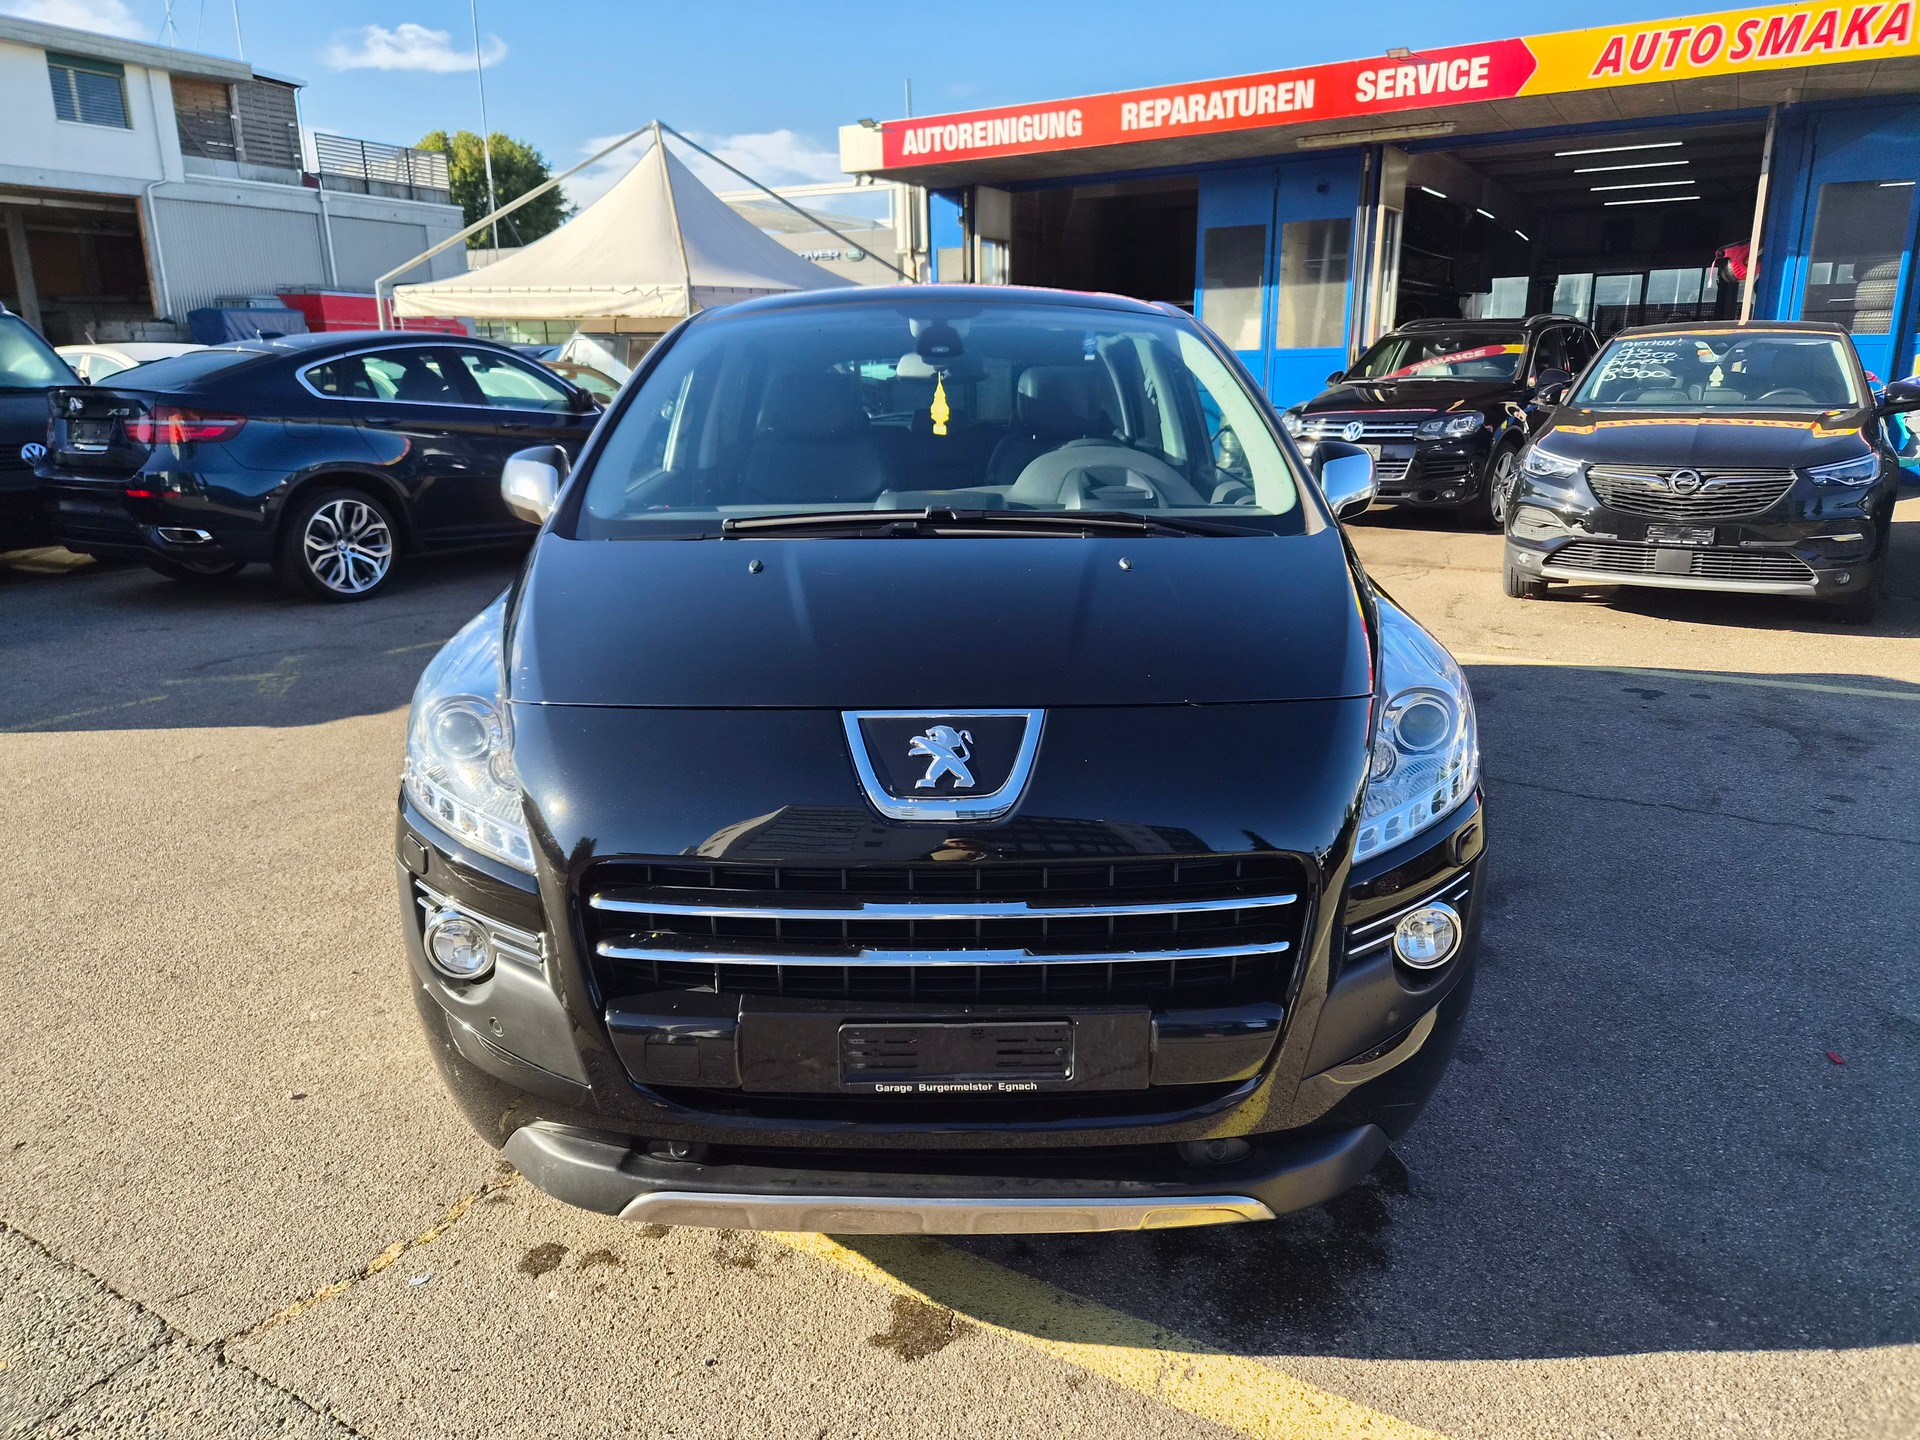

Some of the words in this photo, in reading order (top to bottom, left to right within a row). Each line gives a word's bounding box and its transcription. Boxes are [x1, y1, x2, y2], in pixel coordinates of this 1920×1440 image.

[1592, 24, 1724, 76] AUTO
[1730, 2, 1909, 60] SMAKA
[902, 109, 1083, 156] AUTOREINIGUNG
[1120, 79, 1315, 131] REPARATUREN
[1355, 56, 1490, 103] SERVICE
[875, 1083, 913, 1093] Garage
[918, 1082, 993, 1093] Burgermeister
[998, 1082, 1038, 1092] Egnach
